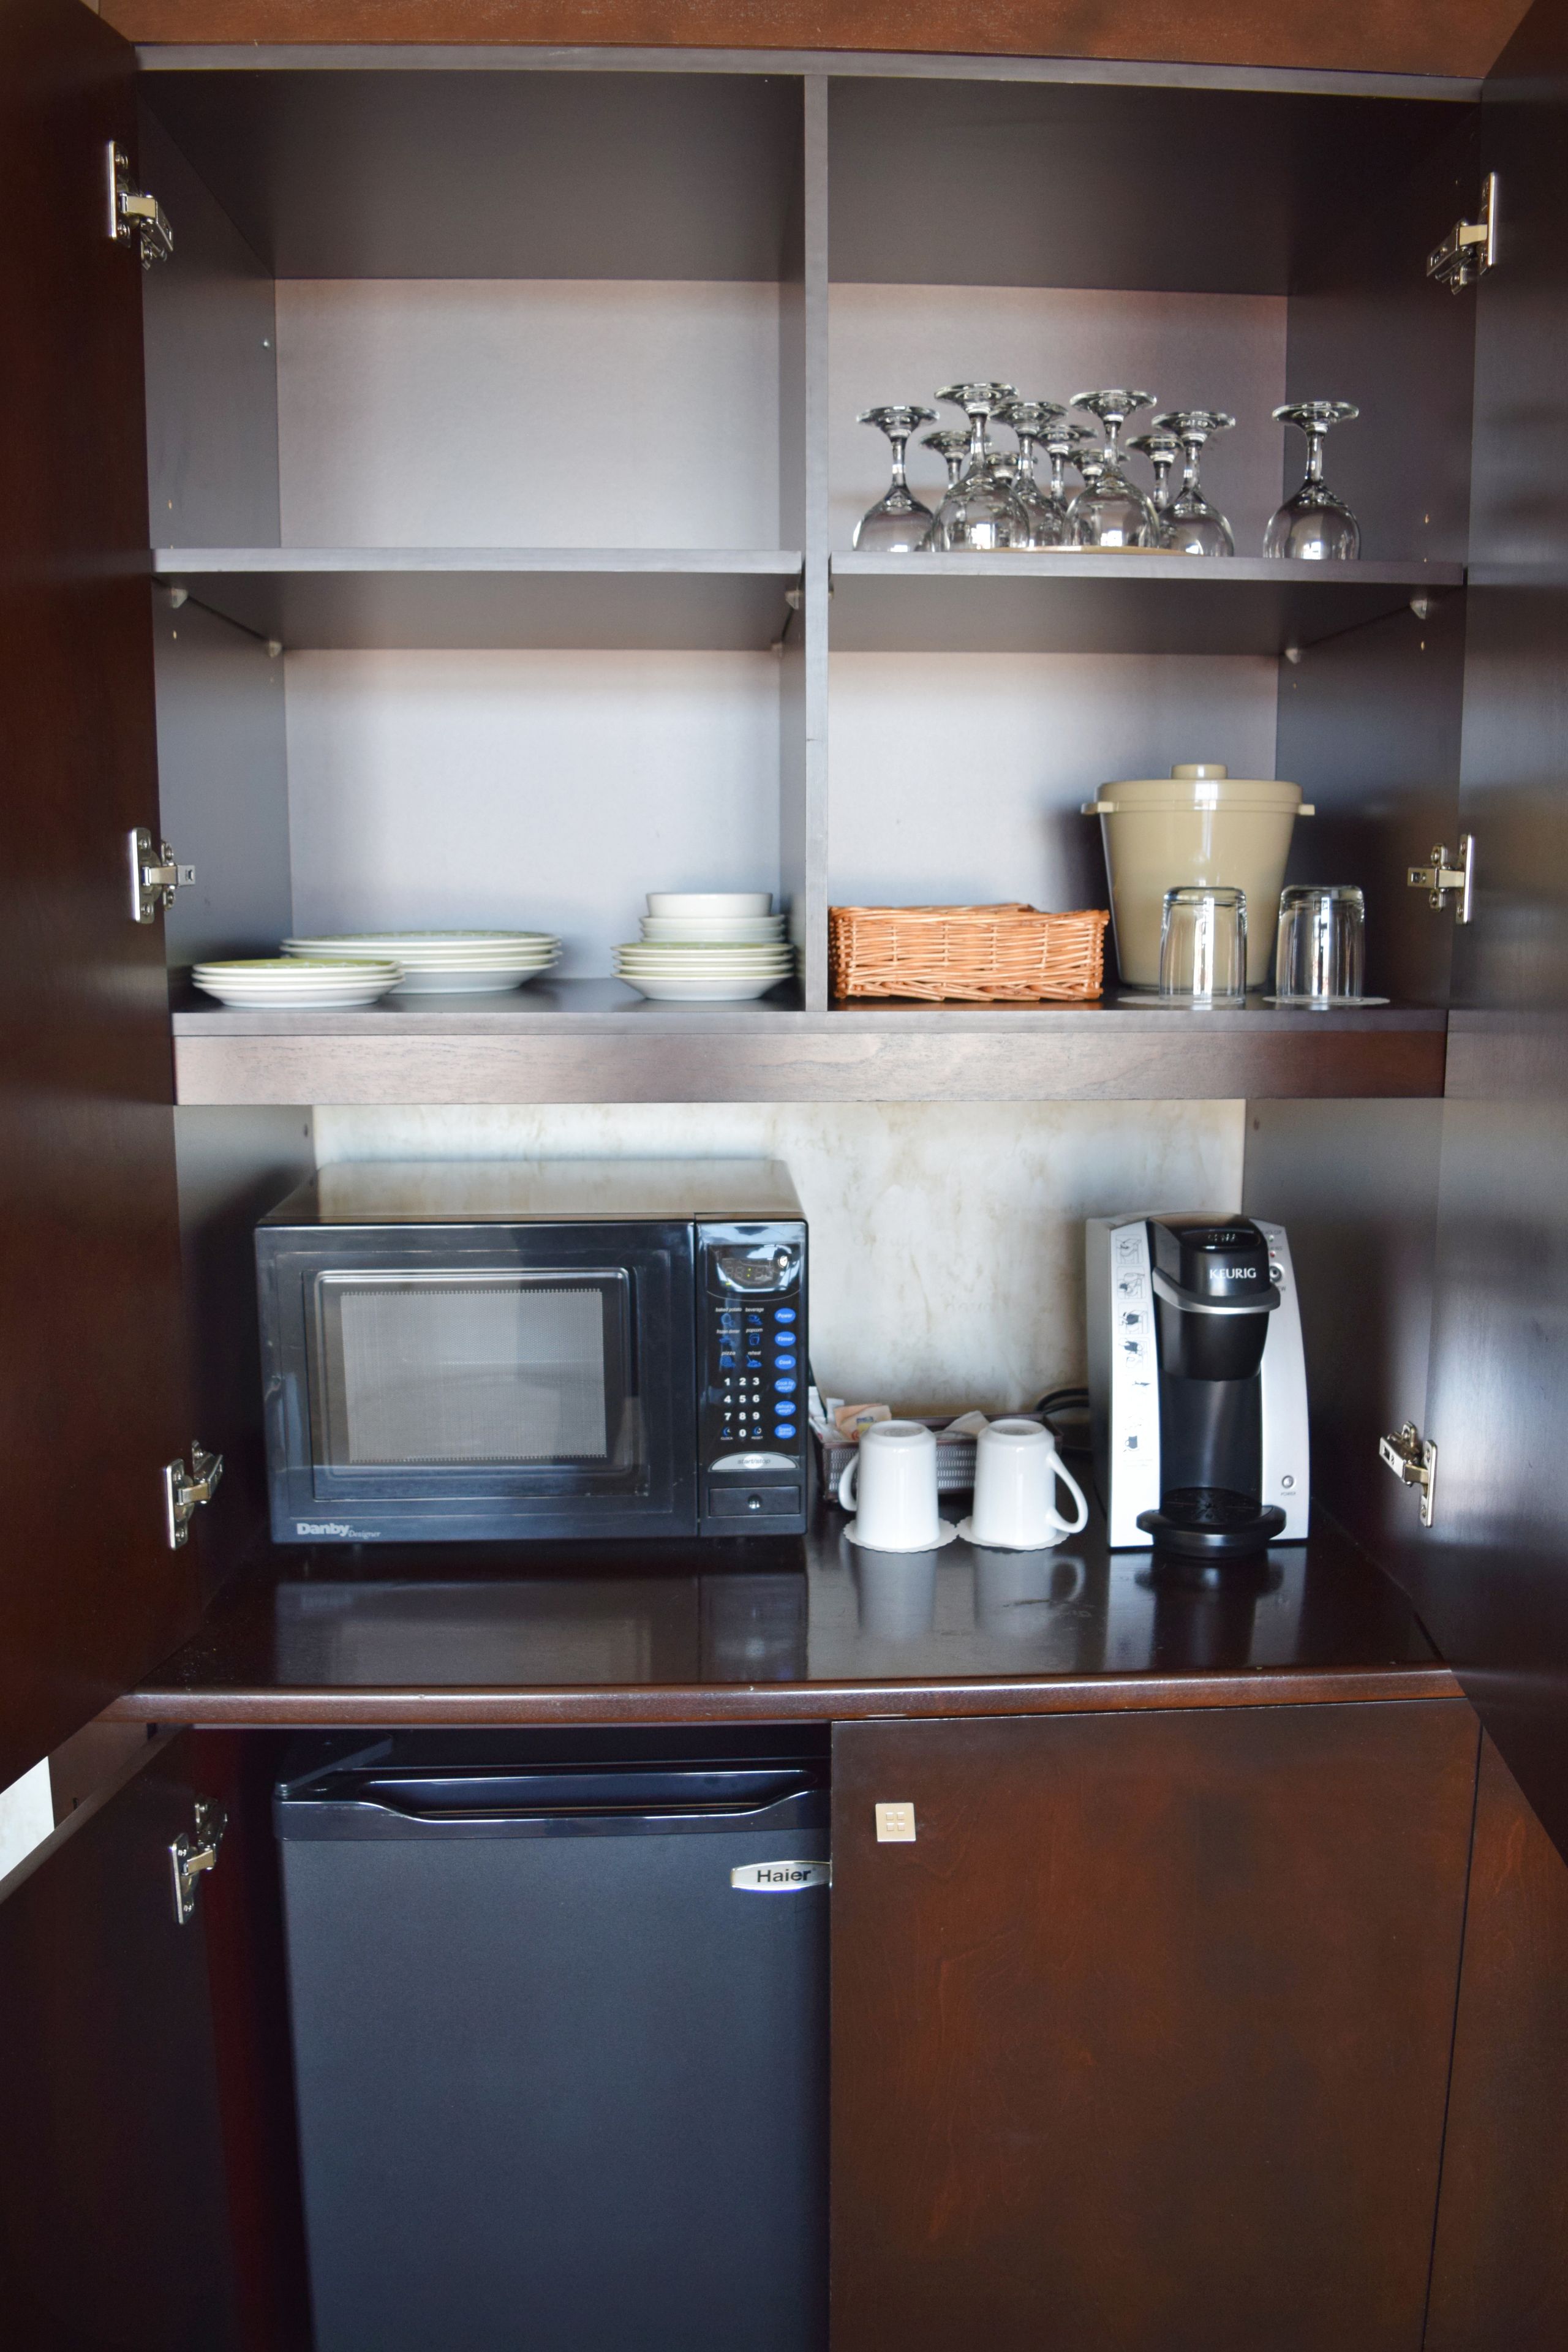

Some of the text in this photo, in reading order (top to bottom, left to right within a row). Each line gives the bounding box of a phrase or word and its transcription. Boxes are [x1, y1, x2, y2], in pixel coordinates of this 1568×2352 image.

[1209, 1268, 1256, 1279] KEURIG
[724, 1377, 760, 1386] 1 2 3
[724, 1395, 731, 1403] 4
[724, 1412, 731, 1421] 7
[739, 1412, 746, 1420] 8
[296, 1523, 350, 1537] Danby
[757, 1869, 811, 1883] Haier
